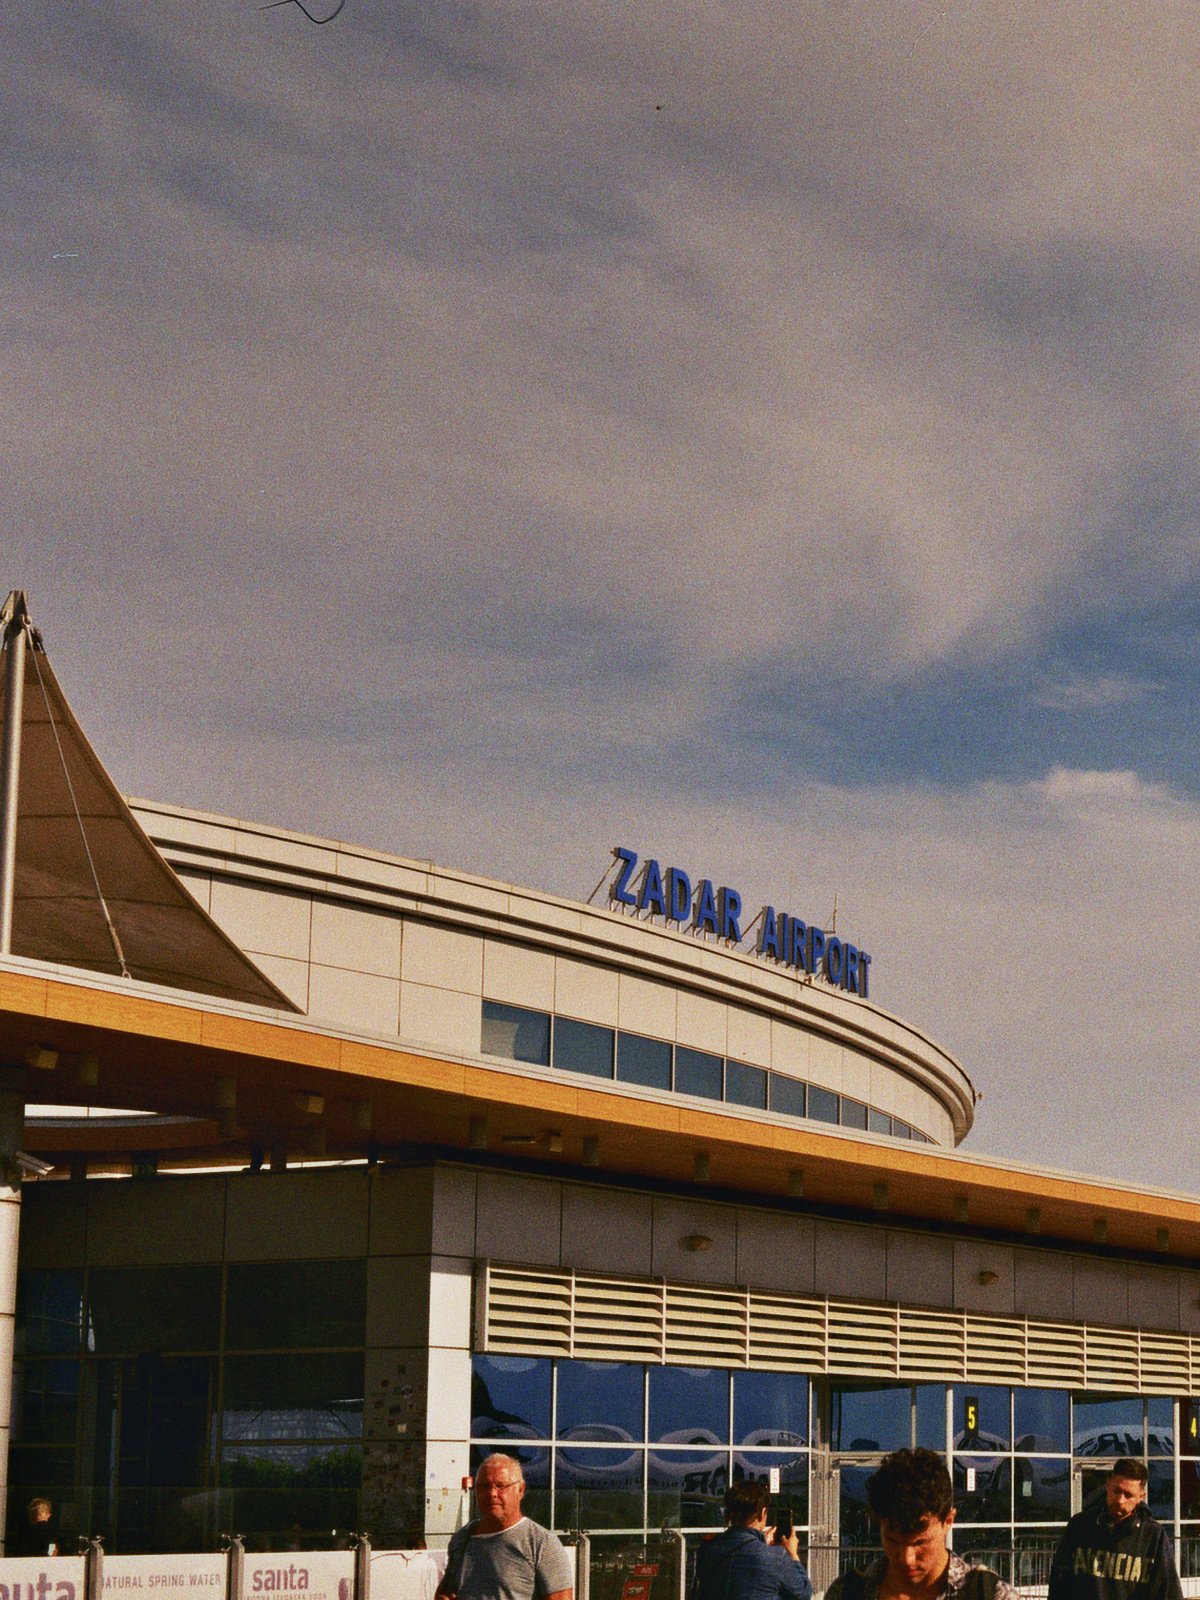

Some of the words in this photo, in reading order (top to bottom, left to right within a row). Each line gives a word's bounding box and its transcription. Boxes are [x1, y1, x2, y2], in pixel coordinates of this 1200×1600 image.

[612, 847, 742, 942] ZADAR
[759, 906, 871, 998] AIRPORT
[968, 1406, 976, 1430] 5
[1190, 1417, 1197, 1438] 4
[103, 1575, 143, 1589] ATURAL
[148, 1574, 184, 1588] SPRING
[189, 1573, 221, 1586] WATER
[252, 1564, 309, 1591] santa
